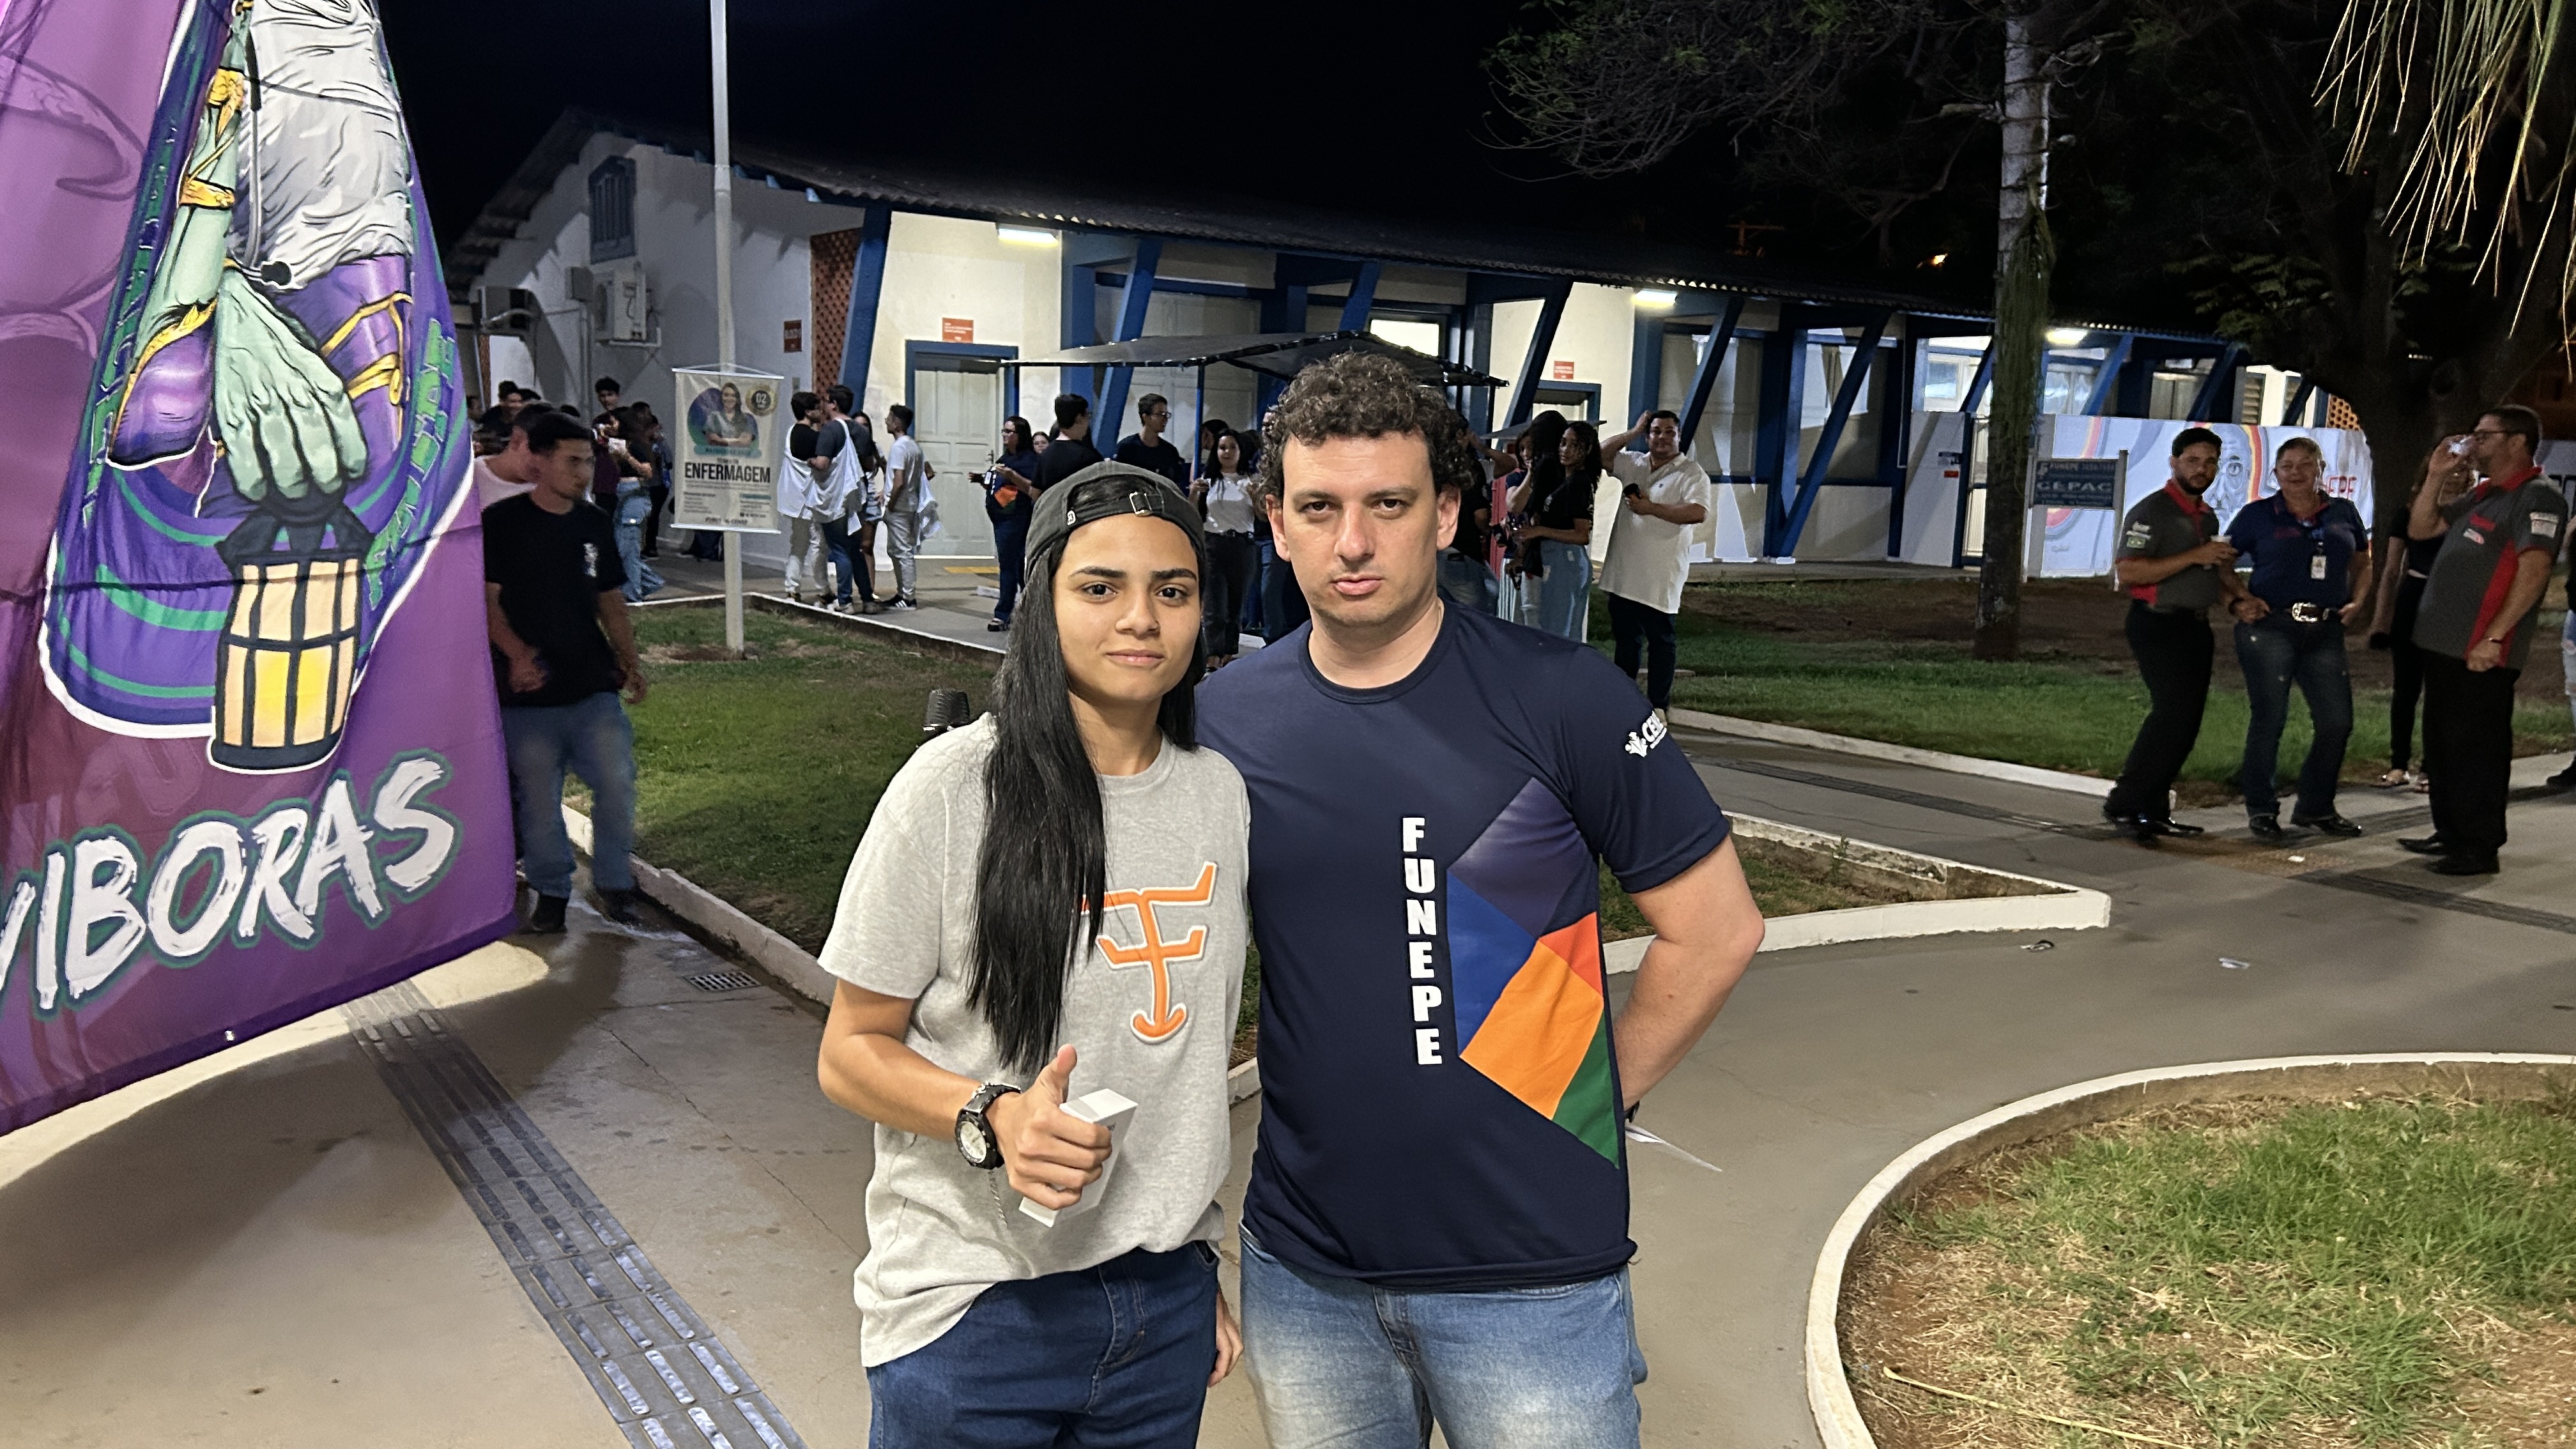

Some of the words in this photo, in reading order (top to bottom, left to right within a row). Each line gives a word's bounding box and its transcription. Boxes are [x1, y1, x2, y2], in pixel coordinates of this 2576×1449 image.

[756, 393, 767, 403] 02
[684, 461, 771, 483] ENFERMAGEM
[1402, 816, 1443, 1066] FUNEPE
